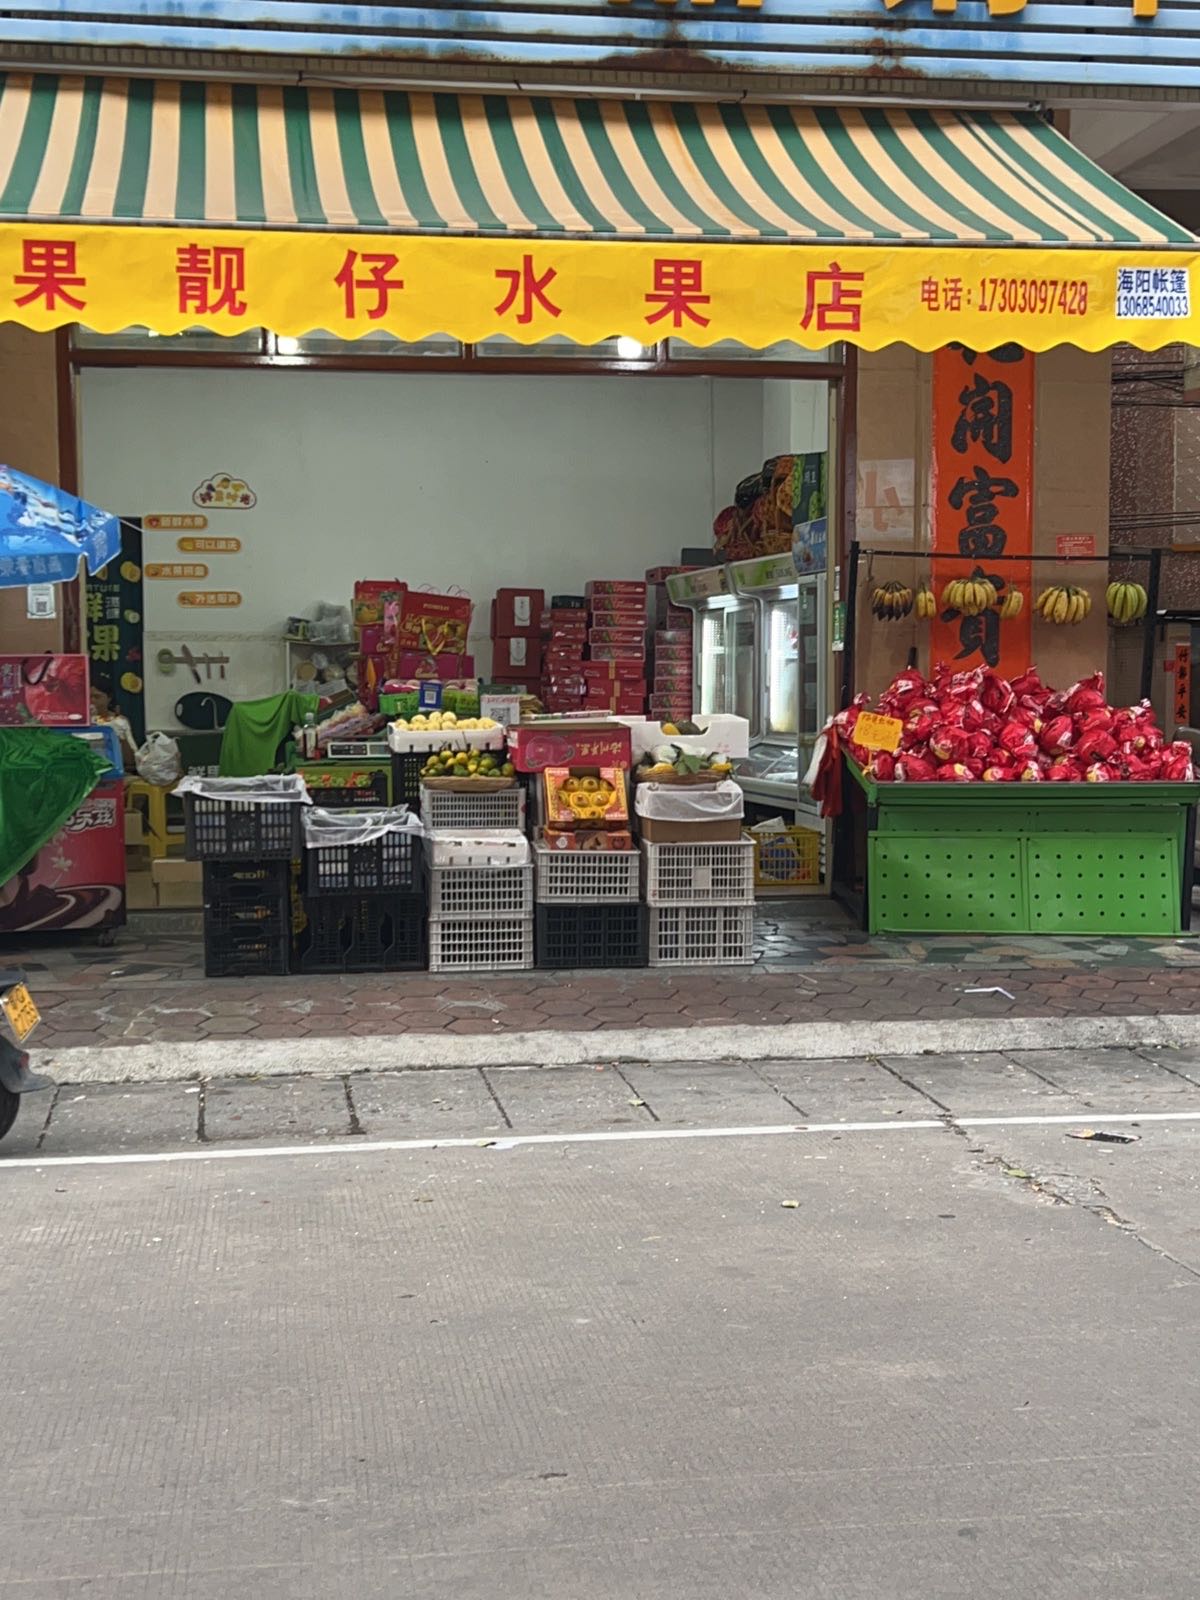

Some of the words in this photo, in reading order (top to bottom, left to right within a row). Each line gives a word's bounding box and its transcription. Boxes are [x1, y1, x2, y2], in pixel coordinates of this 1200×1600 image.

[1117, 268, 1187, 294] 海阳帐篷
[1116, 295, 1189, 317] 13068540033
[940, 341, 1026, 668] 開富貴
